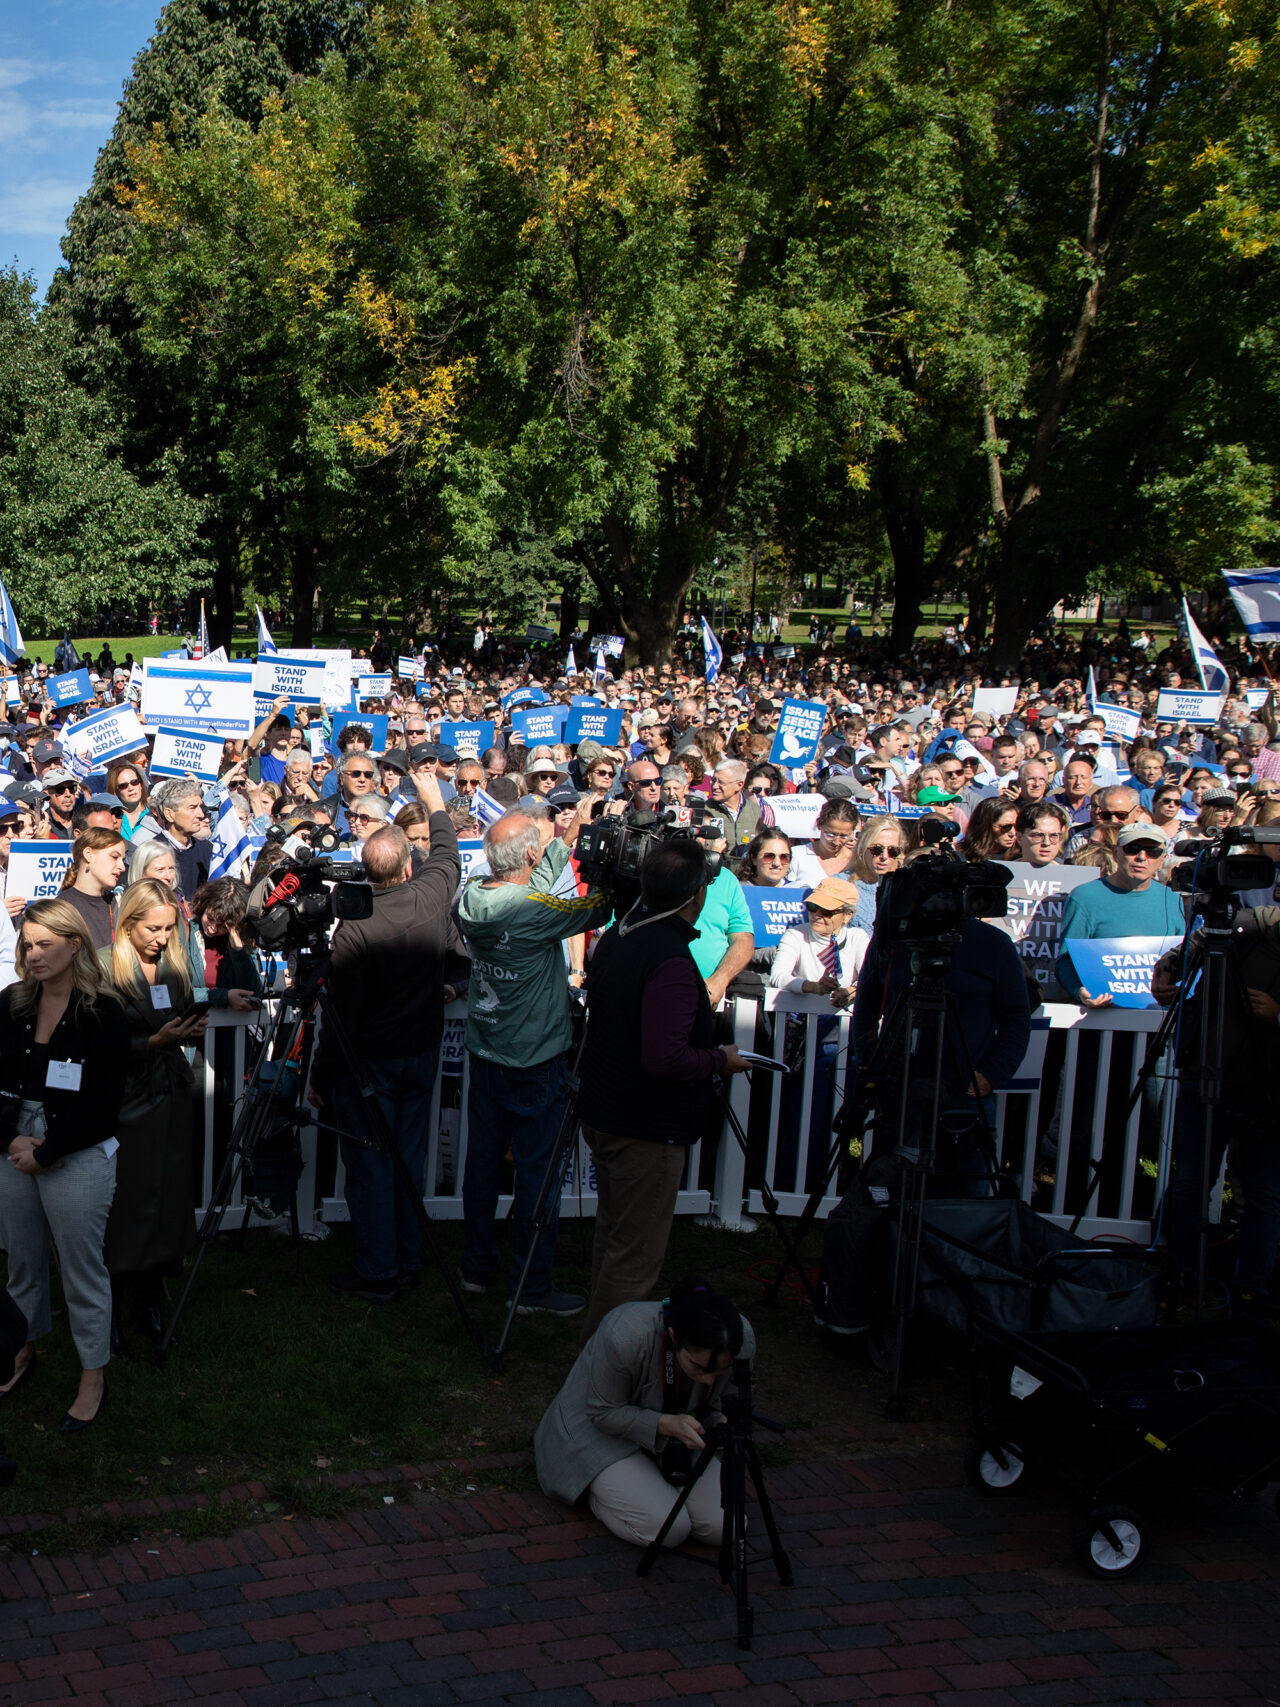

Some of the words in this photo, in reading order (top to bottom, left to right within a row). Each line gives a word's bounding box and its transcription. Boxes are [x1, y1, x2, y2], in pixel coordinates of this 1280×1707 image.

[274, 666, 306, 676] STAND
[56, 678, 78, 688] STAND
[276, 675, 303, 684] WITH
[60, 684, 78, 693] WITH
[272, 684, 305, 694] ISRAEL
[59, 690, 82, 700] ISRAEL
[786, 706, 822, 720] ISRAEL
[1108, 712, 1130, 721] STAND
[526, 715, 554, 725] STAND
[783, 715, 820, 730] SEEKS
[1110, 718, 1127, 726] WITH
[86, 718, 118, 737] STAND
[583, 722, 604, 730] WITH
[92, 728, 120, 744] WITH
[454, 730, 481, 738] STAND
[527, 730, 556, 739] ISRAEL
[578, 729, 605, 737] ISRAEL
[780, 725, 818, 741] PEACE
[92, 736, 128, 754] ISRAEL
[174, 739, 206, 751] STAND
[457, 737, 479, 745] WITH
[177, 749, 202, 760] WITH
[170, 758, 202, 770] ISRAEL
[778, 804, 797, 812] With
[38, 857, 74, 868] STAN
[1024, 879, 1062, 897] WE
[761, 901, 806, 912] STAND
[1007, 899, 1062, 918] STAN
[1011, 919, 1061, 939] WIT
[1108, 981, 1152, 994] ISRA
